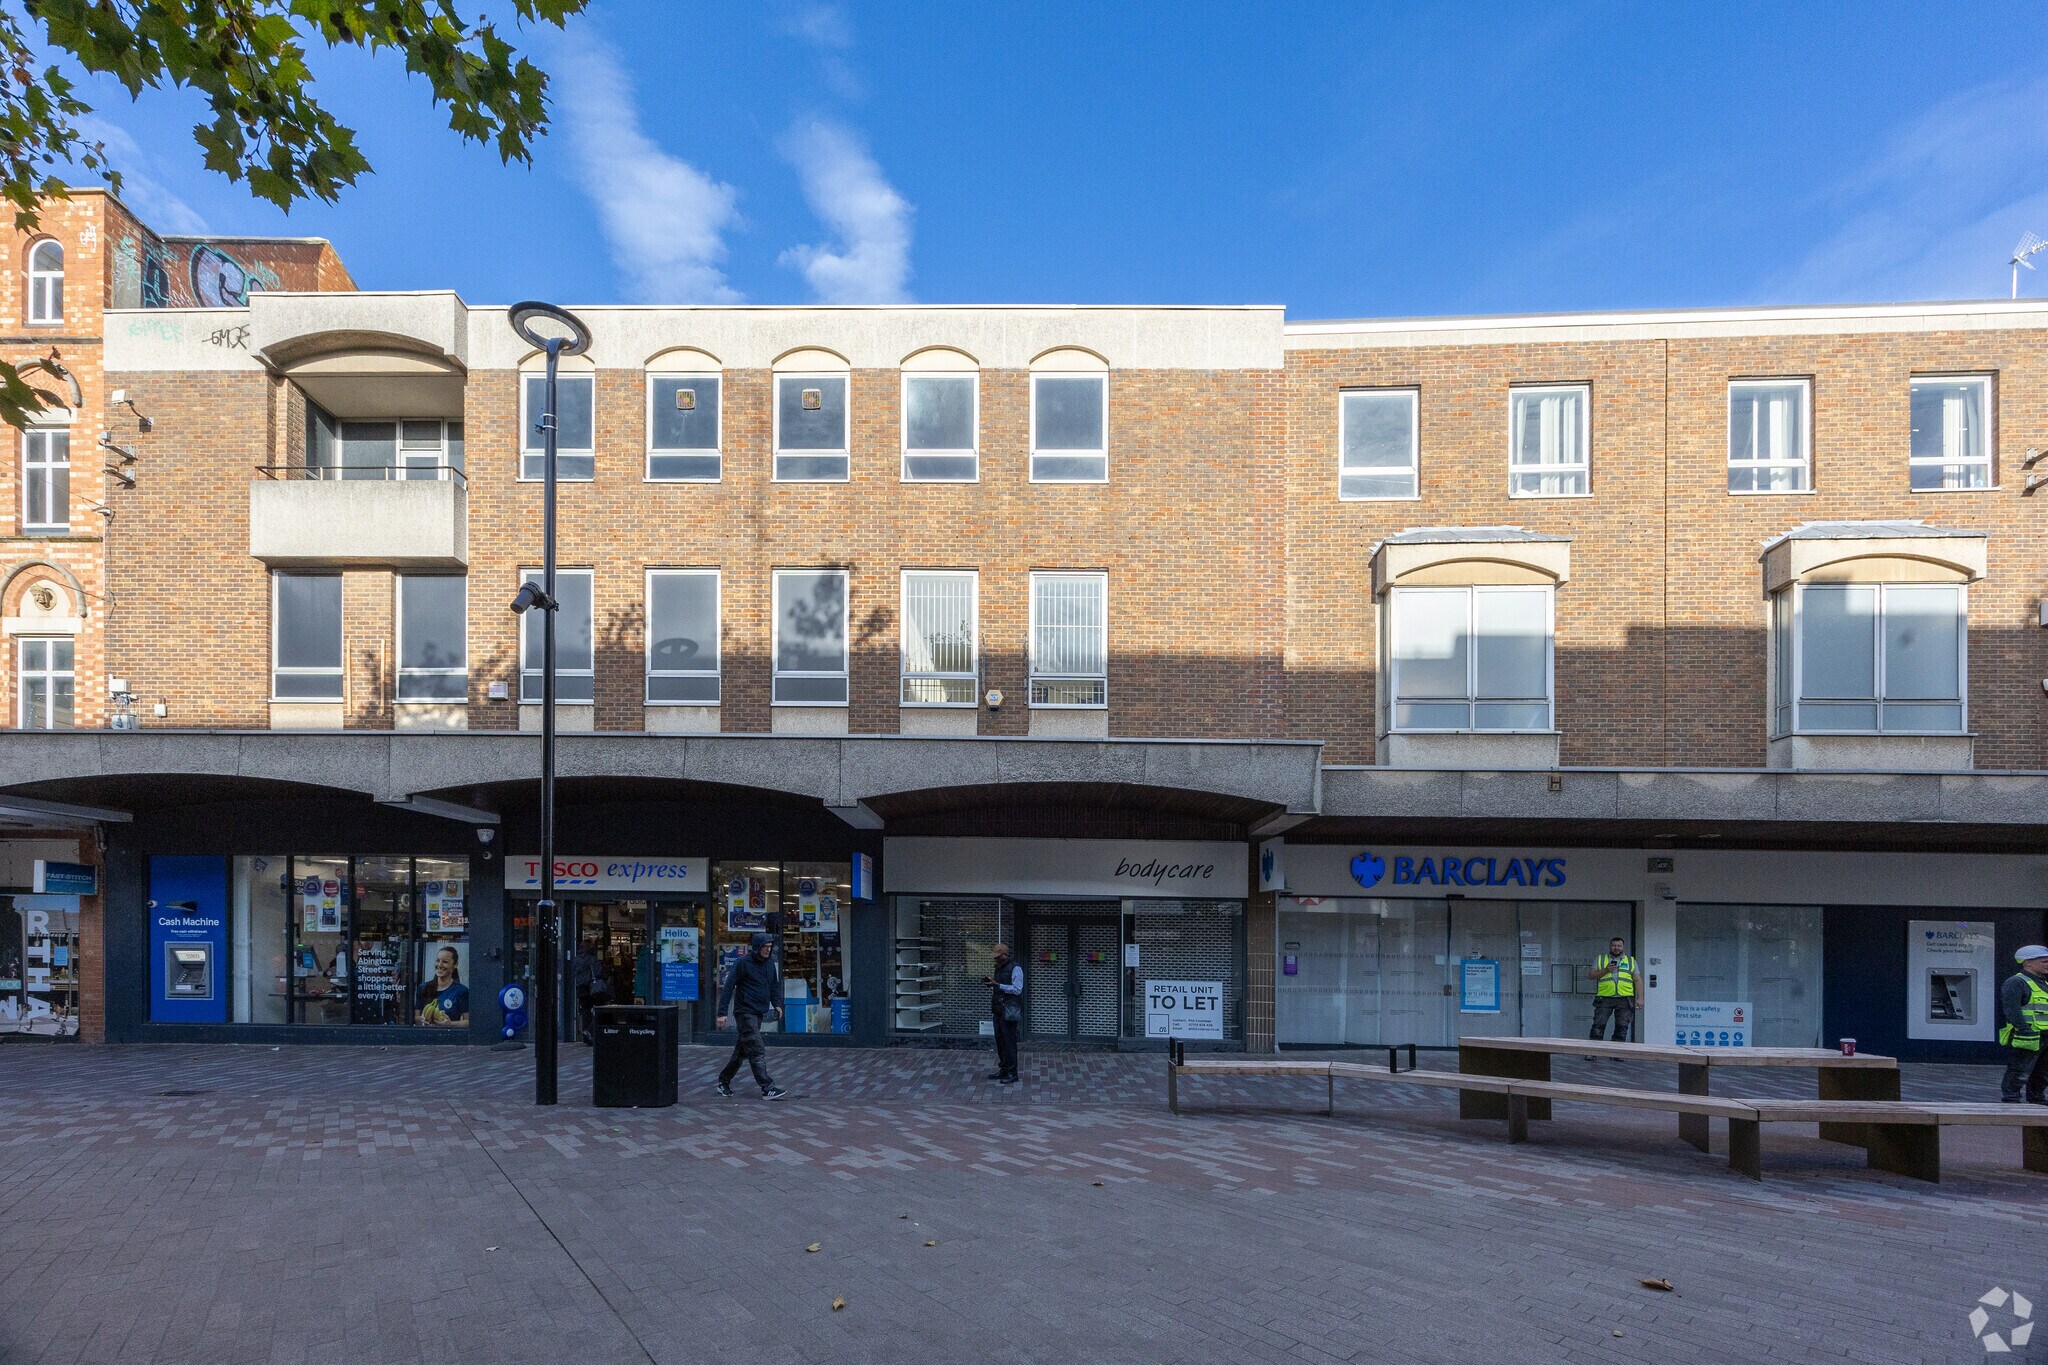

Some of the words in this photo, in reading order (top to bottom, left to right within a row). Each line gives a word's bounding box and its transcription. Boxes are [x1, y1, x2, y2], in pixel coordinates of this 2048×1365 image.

[525, 862, 598, 877] TSCO
[607, 861, 687, 883] express
[1114, 857, 1214, 886] bodycare
[1393, 857, 1566, 887] BARCLAYS
[46, 873, 92, 882] FAST-STITCH
[159, 917, 181, 926] Cash
[182, 917, 220, 926] Machine
[665, 929, 690, 938] Hello.
[1936, 931, 1979, 940] BARCLAYS
[358, 949, 386, 958] Serving
[357, 957, 393, 966] Abington
[357, 965, 388, 974] Street's
[357, 974, 394, 984] shoppers
[363, 983, 381, 991] little
[382, 983, 407, 991] better
[1154, 985, 1187, 993] RETAIL
[1190, 986, 1214, 994] UNIT
[357, 992, 380, 1001] every
[380, 992, 394, 1001] day
[1149, 995, 1176, 1009] TO
[1183, 996, 1219, 1010] LET
[1700, 1005, 1721, 1013] safety
[629, 1028, 656, 1036] Recycling
